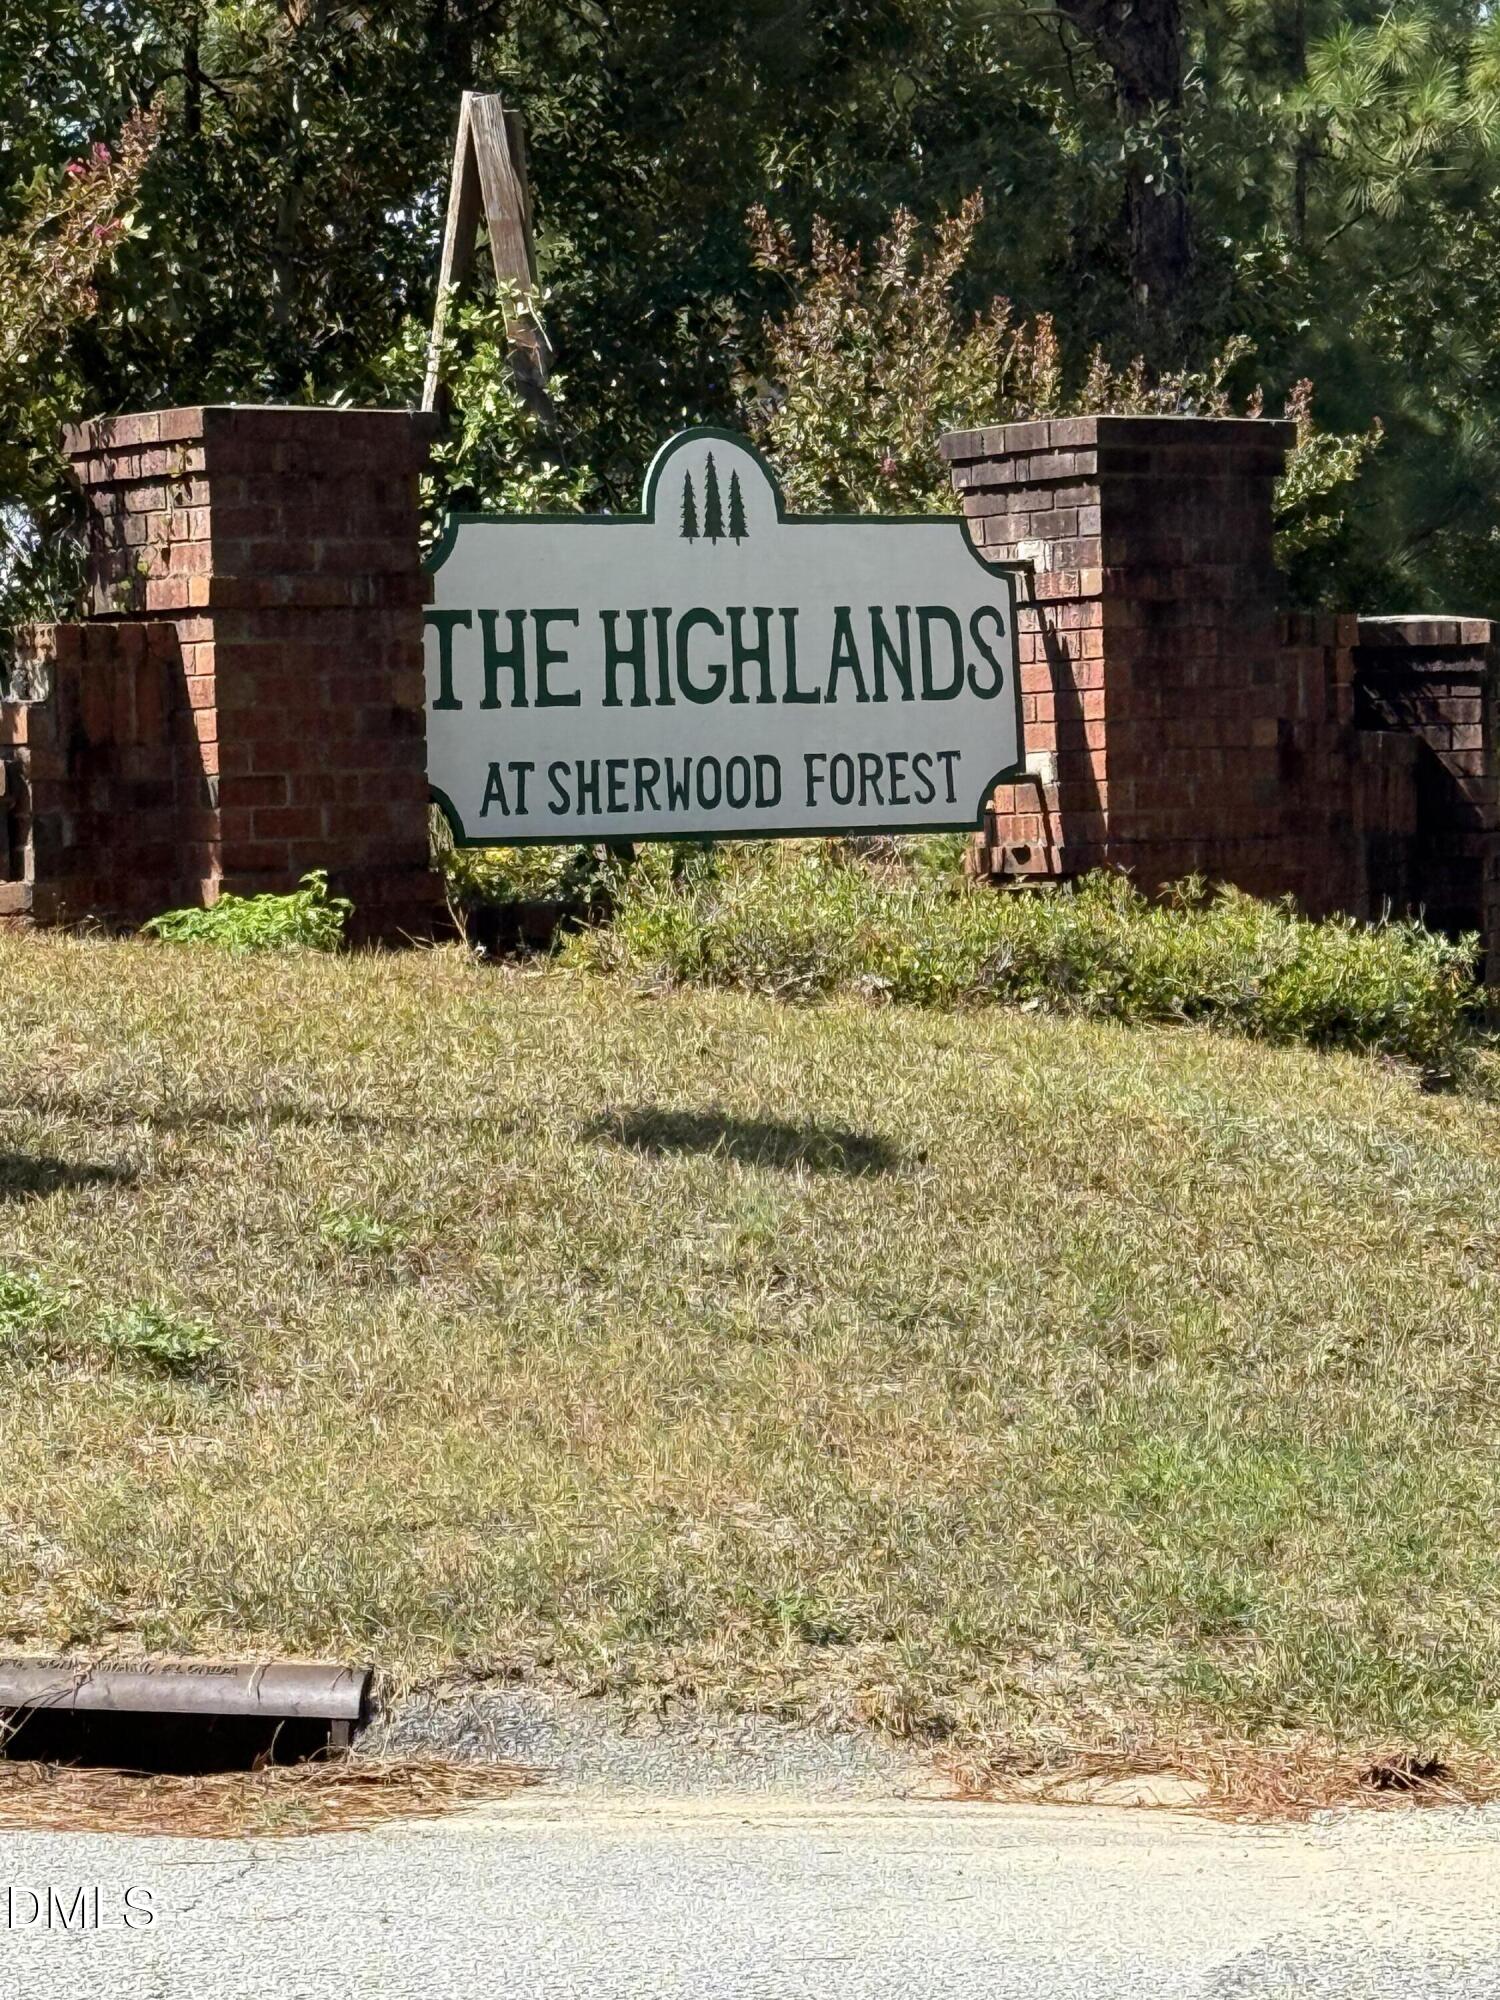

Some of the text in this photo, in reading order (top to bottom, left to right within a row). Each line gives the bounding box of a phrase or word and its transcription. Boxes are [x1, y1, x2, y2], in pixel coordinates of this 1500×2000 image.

[423, 605, 1005, 710] THE HIGHLANDS
[479, 750, 961, 818] AT SHERWOOD FOREST
